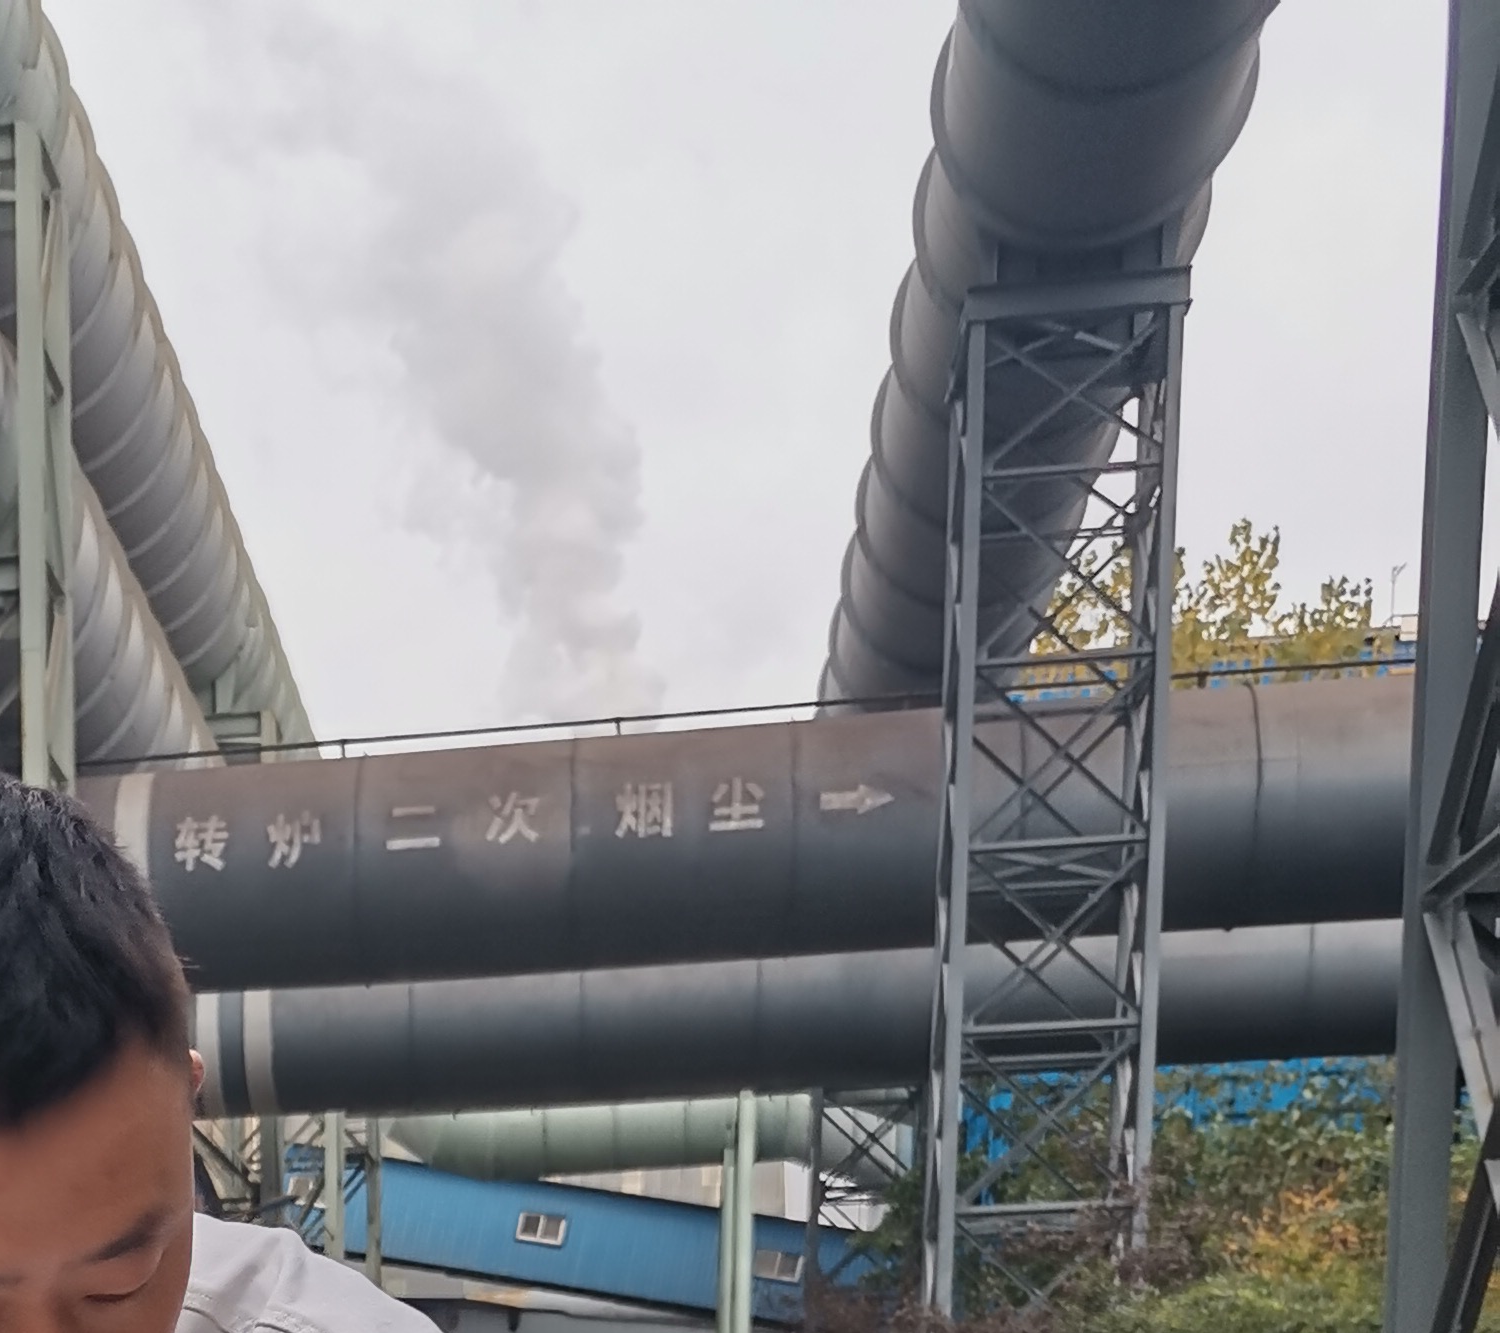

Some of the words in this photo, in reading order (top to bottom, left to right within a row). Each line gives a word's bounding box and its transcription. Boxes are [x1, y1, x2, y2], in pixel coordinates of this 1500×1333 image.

[174, 778, 765, 872] 转炉二次烟尘
